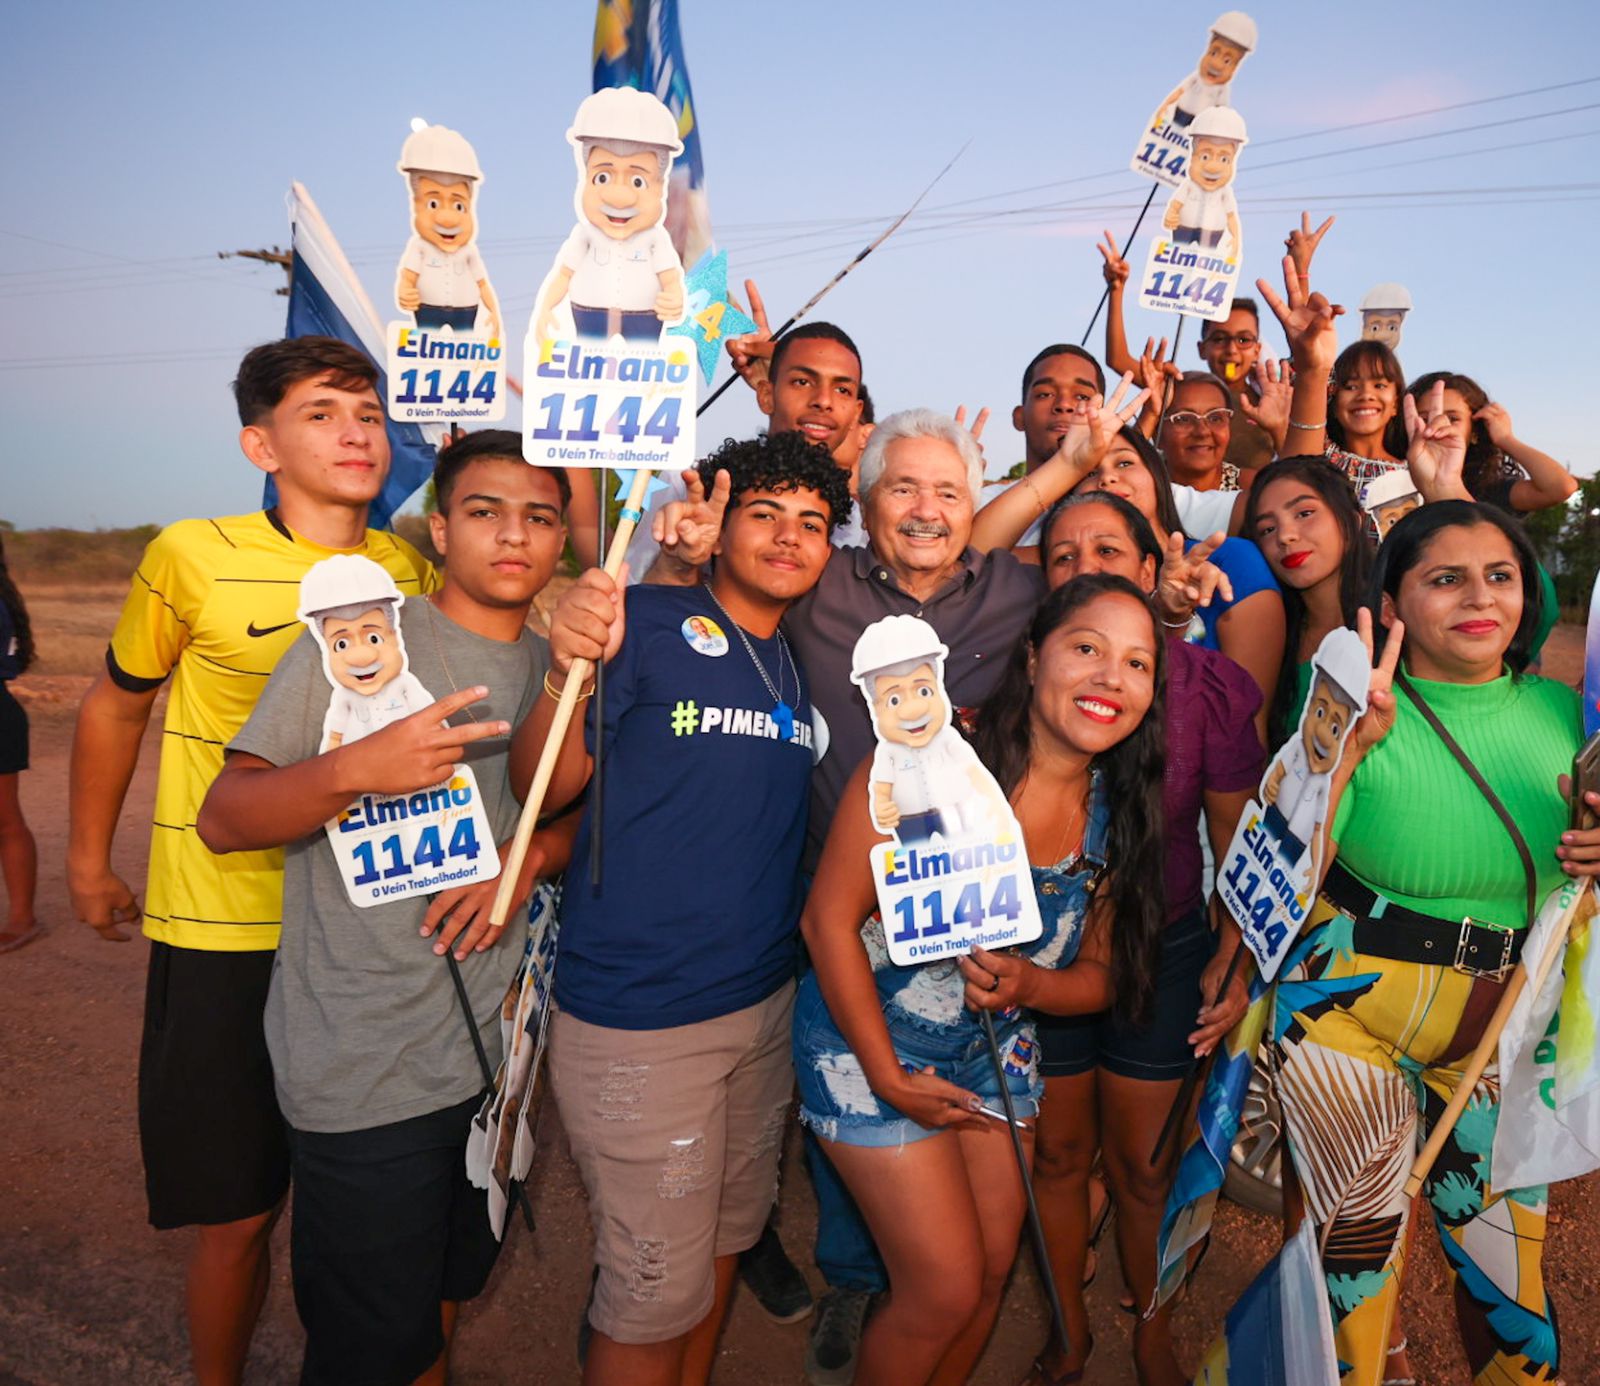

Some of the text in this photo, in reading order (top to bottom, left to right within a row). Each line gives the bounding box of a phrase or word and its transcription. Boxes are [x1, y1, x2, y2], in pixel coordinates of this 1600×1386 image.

[1136, 142, 1186, 177] 114
[1153, 242, 1236, 275] Elmano
[1143, 270, 1228, 307] 1144
[396, 328, 501, 361] Elmano
[536, 338, 690, 384] Elmano
[395, 368, 497, 404] 1144
[406, 408, 413, 417] O
[436, 408, 490, 417] Trabalhador!
[532, 392, 682, 444] 1144
[547, 447, 556, 459] O
[589, 448, 670, 462] Trabalhador!
[337, 776, 473, 833] Elmano
[352, 816, 481, 886] 1144
[884, 832, 1017, 886] Elmano
[1242, 814, 1308, 922] Elmano
[371, 887, 380, 898] O
[407, 865, 478, 890] Trabalhador!
[894, 874, 1022, 943] 1144
[1225, 853, 1289, 959] 1144
[909, 945, 917, 957] O
[945, 927, 1018, 949] Trabalhador!
